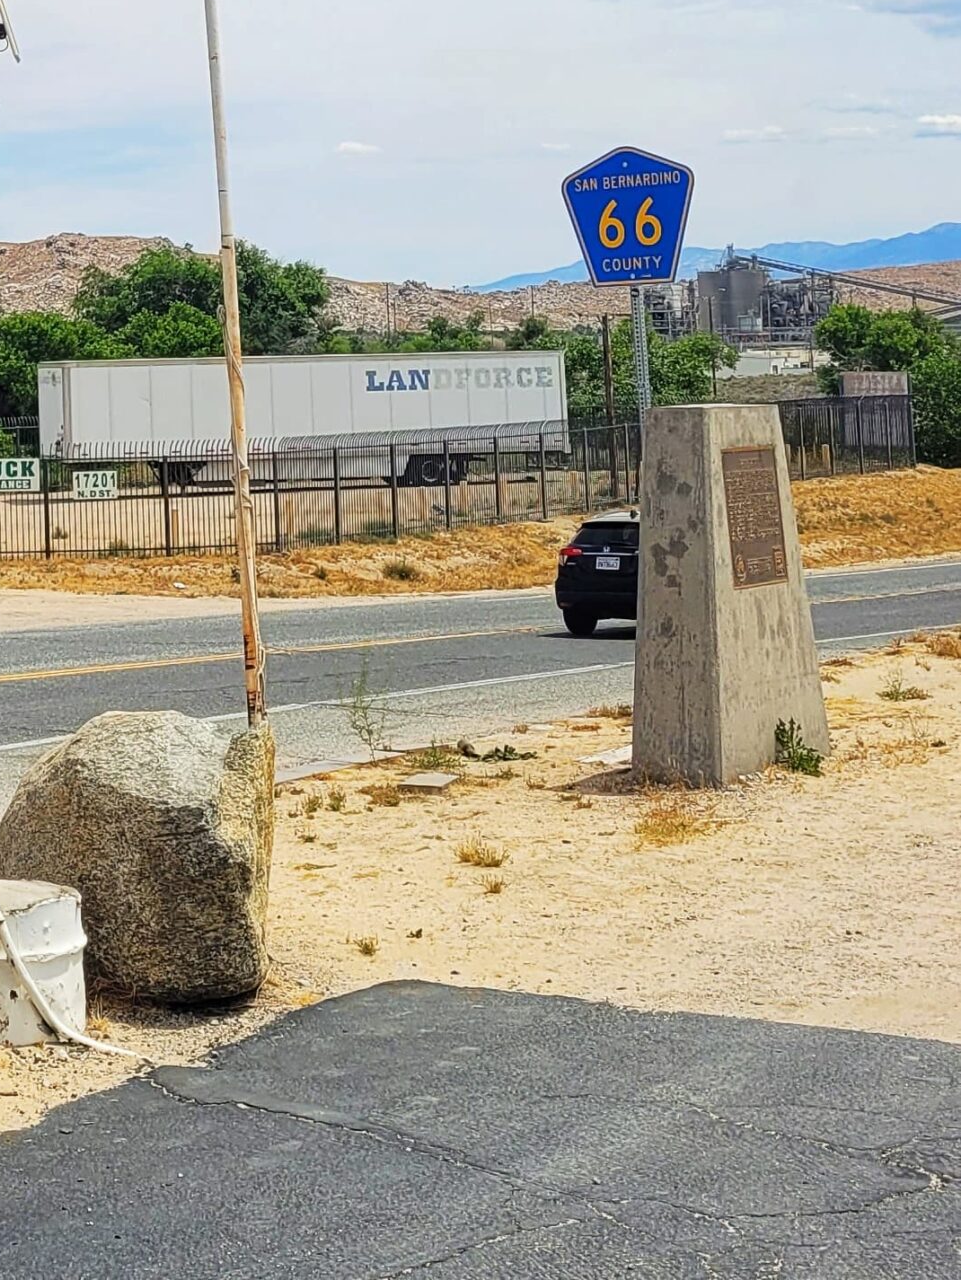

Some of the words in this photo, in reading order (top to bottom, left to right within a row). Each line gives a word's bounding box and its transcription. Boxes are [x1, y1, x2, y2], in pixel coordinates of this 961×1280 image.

[574, 178, 598, 192] SAN
[603, 171, 680, 189] BERNARDINO
[599, 197, 662, 249] 66
[602, 256, 662, 272] COUNTY
[365, 366, 553, 392] LANDFORCE
[75, 472, 116, 489] 17201
